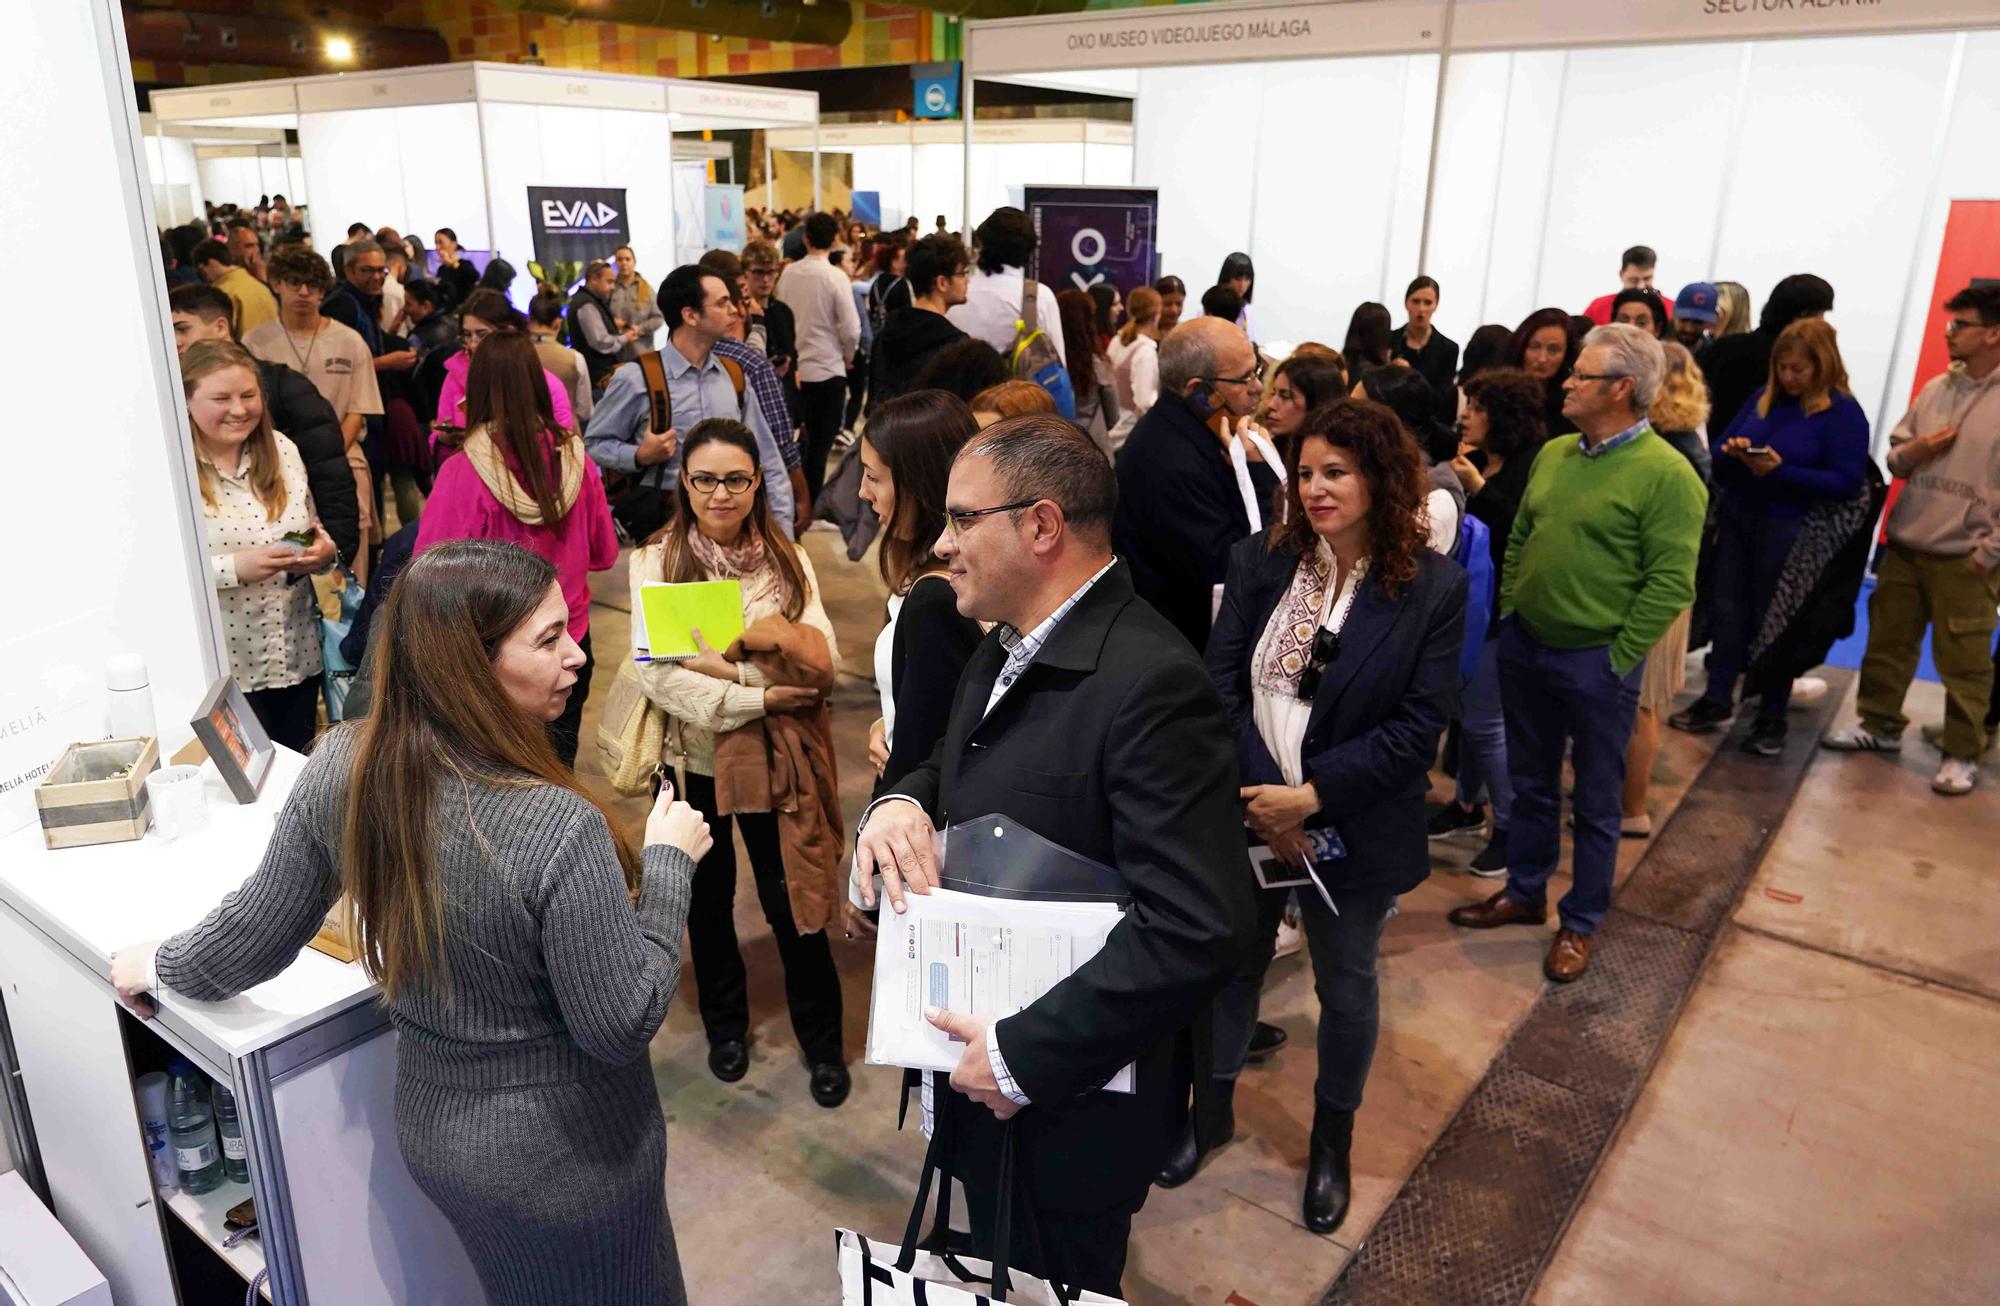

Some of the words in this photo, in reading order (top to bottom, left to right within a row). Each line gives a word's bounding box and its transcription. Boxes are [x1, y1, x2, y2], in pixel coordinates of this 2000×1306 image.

[1067, 34, 1096, 50] OXO
[1100, 30, 1148, 48] MUSEO
[1152, 23, 1244, 45] VIDEOJUEGO
[1248, 19, 1311, 38] MÁLAGA
